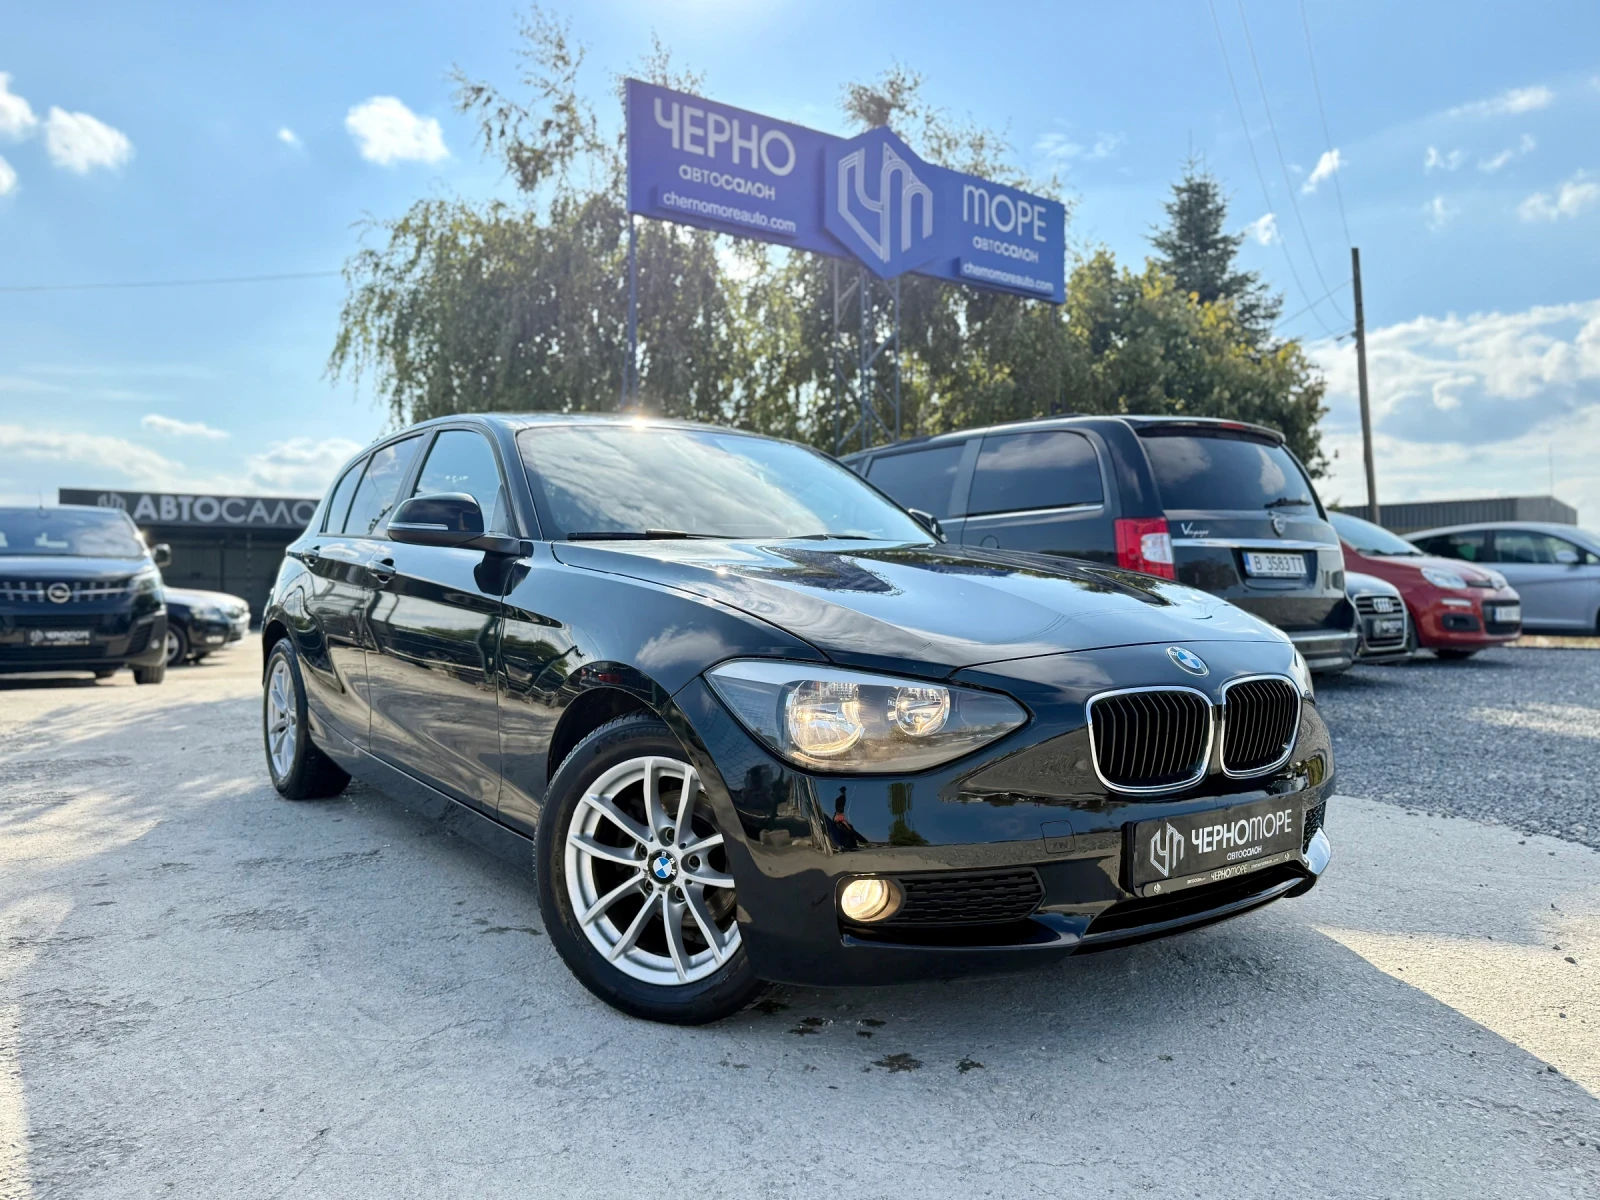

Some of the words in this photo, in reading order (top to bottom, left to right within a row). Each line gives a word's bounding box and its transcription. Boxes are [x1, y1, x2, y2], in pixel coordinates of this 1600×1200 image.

[654, 97, 796, 177] ЧЕРНО
[679, 164, 776, 201] автосалон
[663, 191, 796, 233] chernomoreauto.com
[963, 184, 1047, 243] МОРЕ
[972, 236, 1039, 264] автосалон
[1191, 809, 1293, 854] ЧЕРНОМОРЕ
